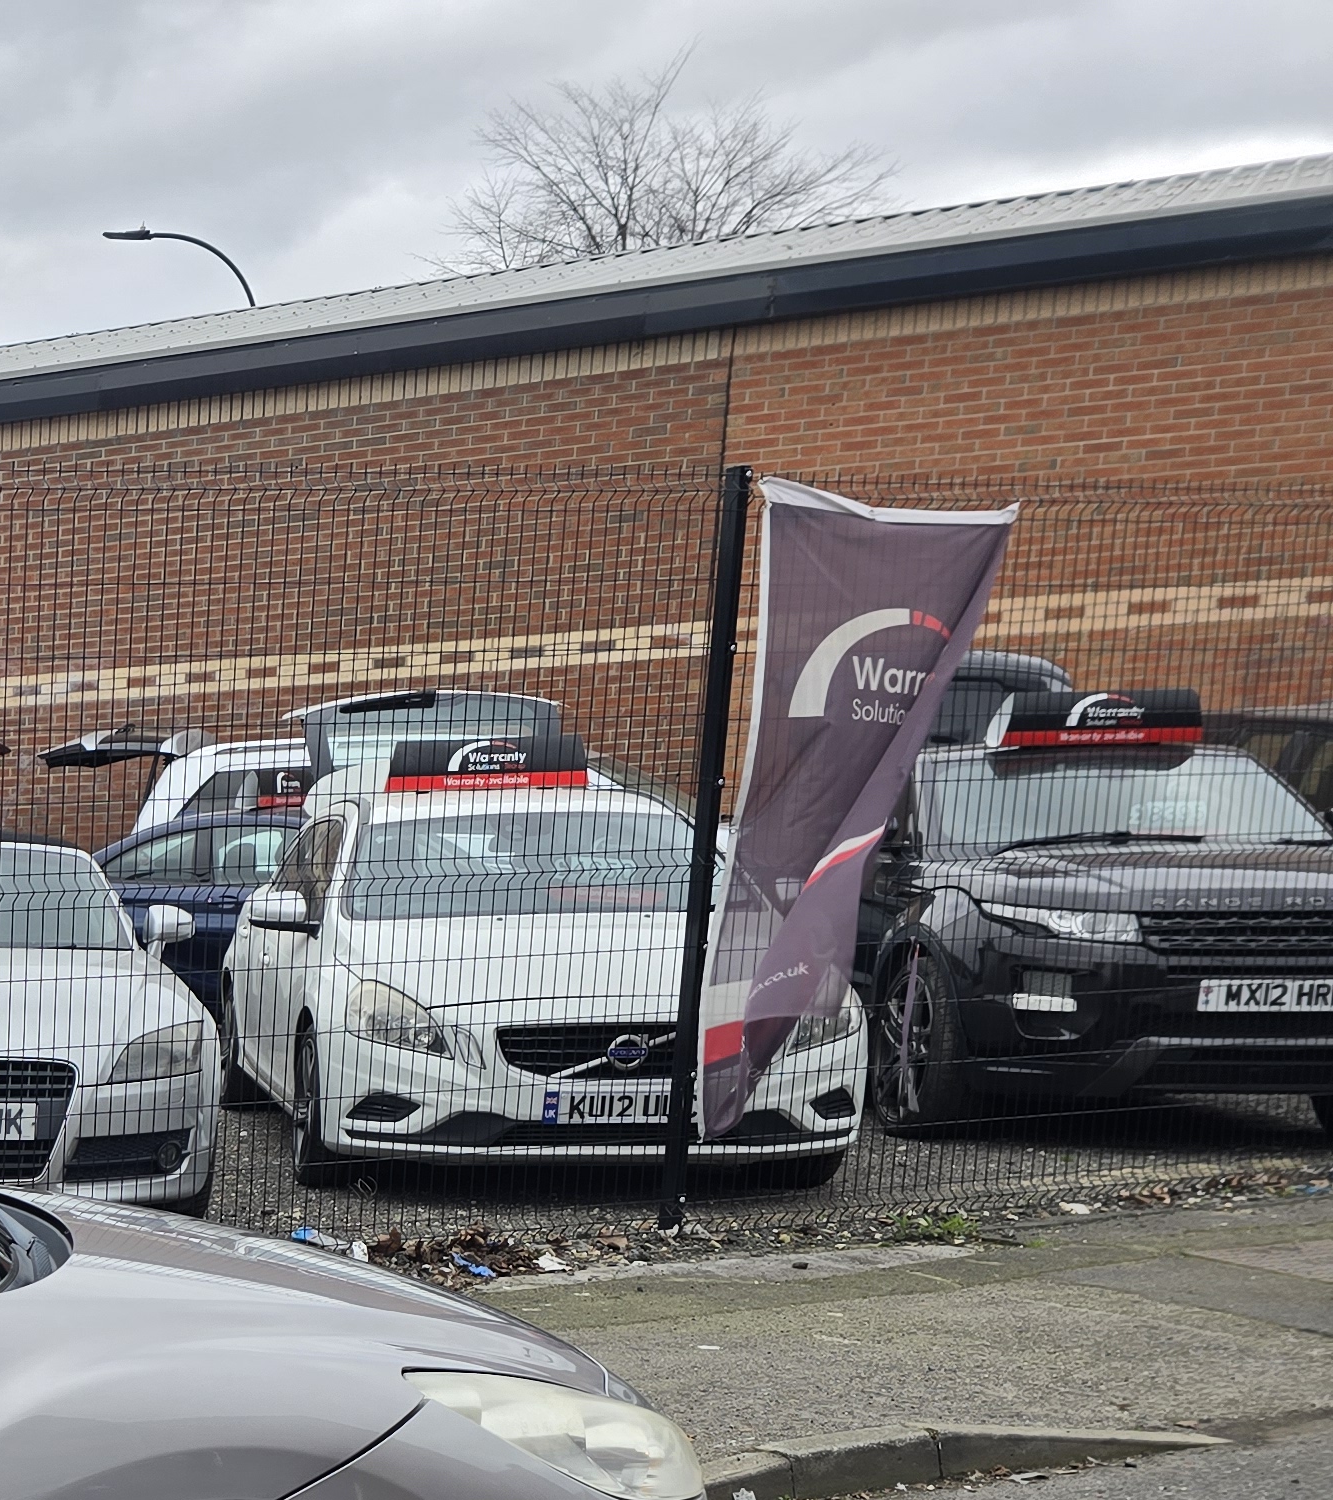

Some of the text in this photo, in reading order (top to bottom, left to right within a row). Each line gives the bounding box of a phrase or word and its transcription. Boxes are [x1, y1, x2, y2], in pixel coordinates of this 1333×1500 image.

[468, 751, 527, 764] Warranty
[443, 776, 484, 787] Warranty
[1224, 983, 1333, 1007] MX12 HR
[569, 1095, 634, 1119] KU12
[544, 1109, 556, 1119] UK
